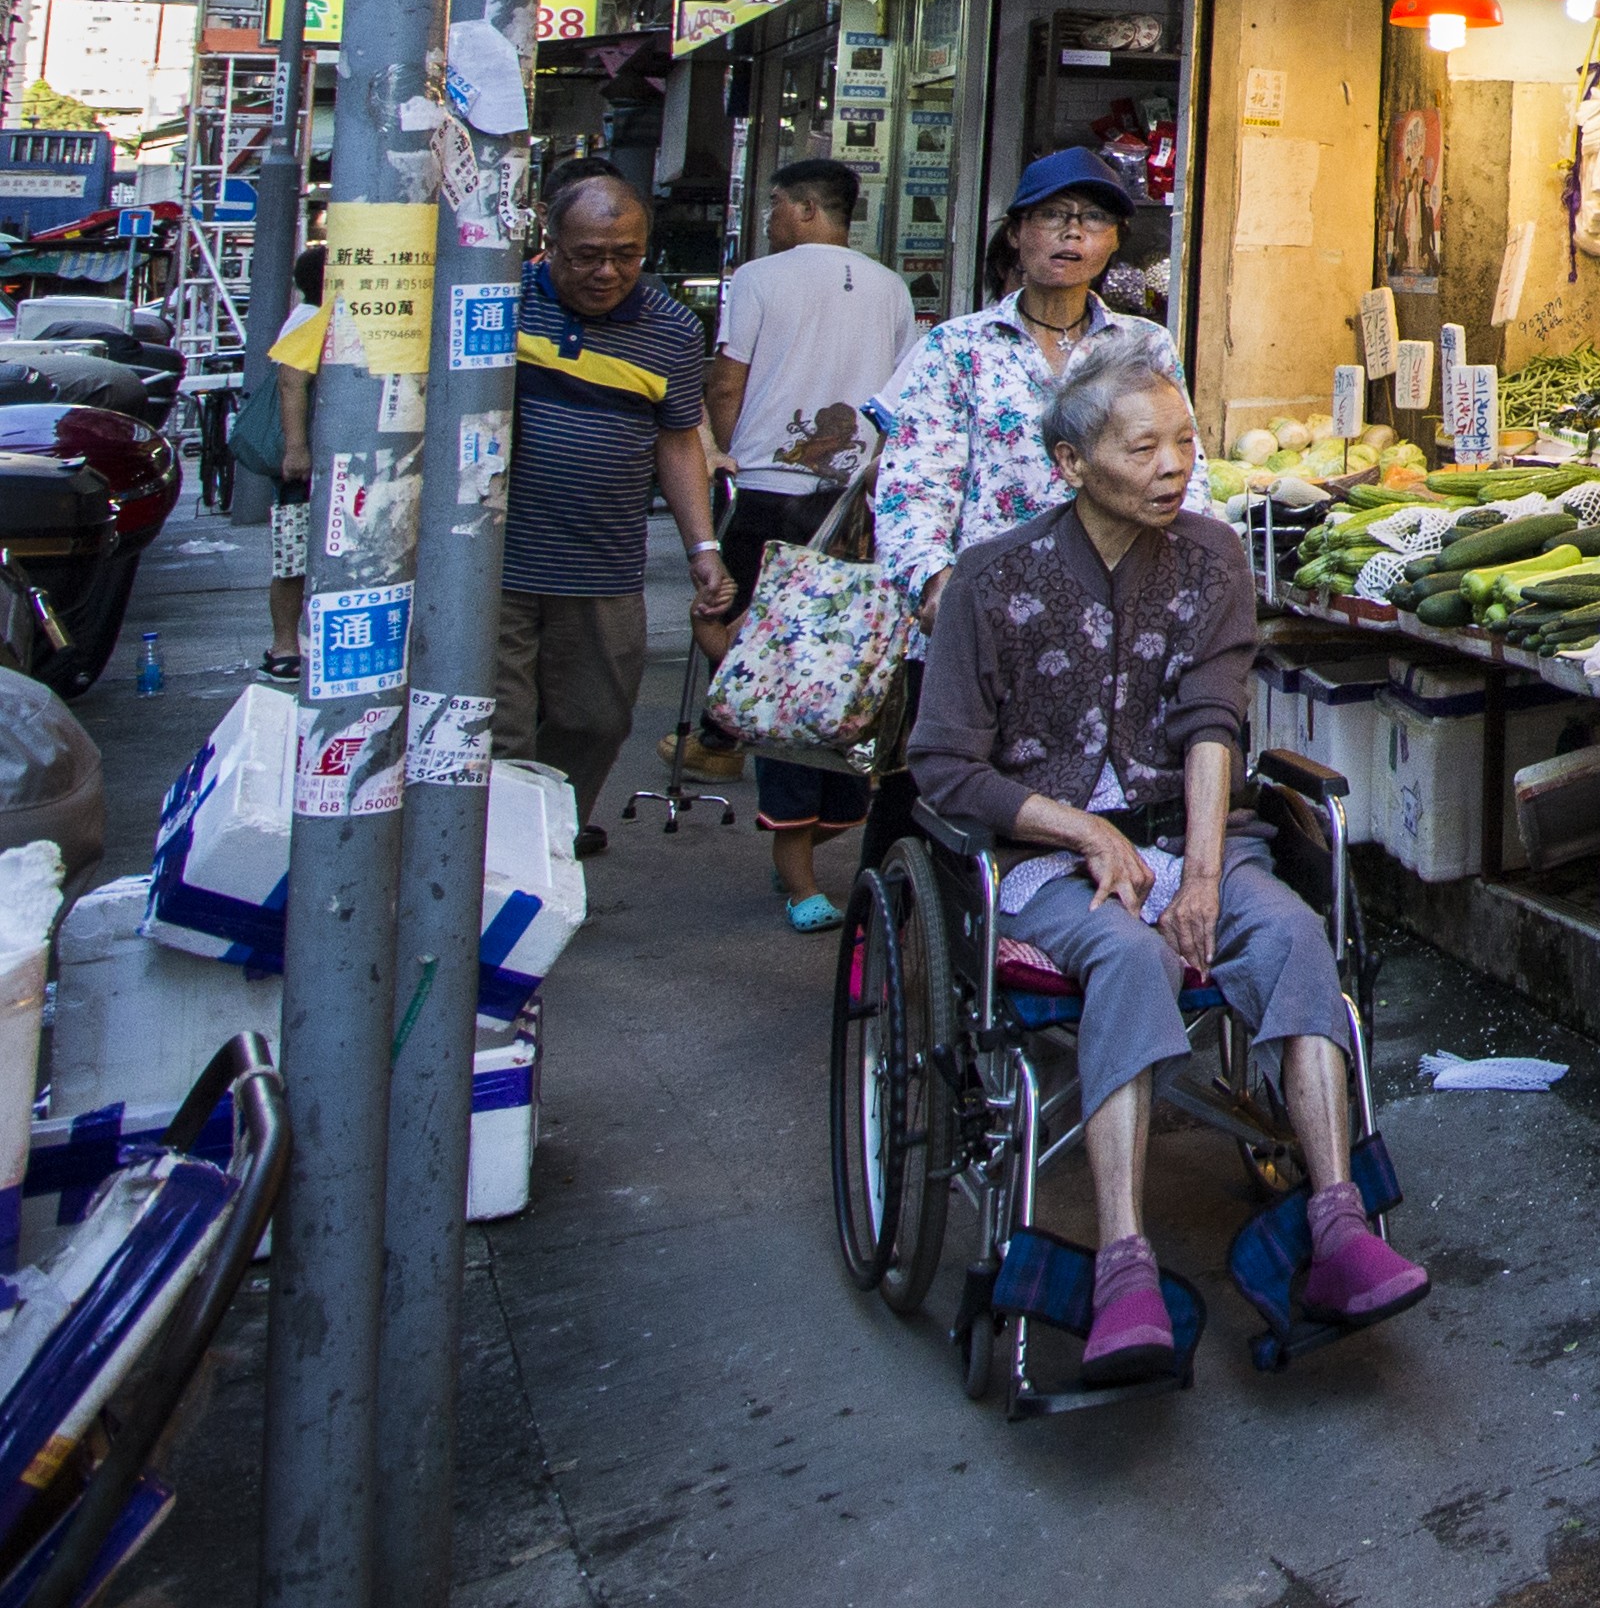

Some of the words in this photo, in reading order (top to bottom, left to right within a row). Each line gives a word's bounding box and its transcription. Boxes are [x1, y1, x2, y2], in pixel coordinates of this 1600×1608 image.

[349, 300, 415, 318] $630萬
[471, 301, 505, 332] 通
[338, 584, 412, 608] 679135
[329, 615, 375, 651] 通
